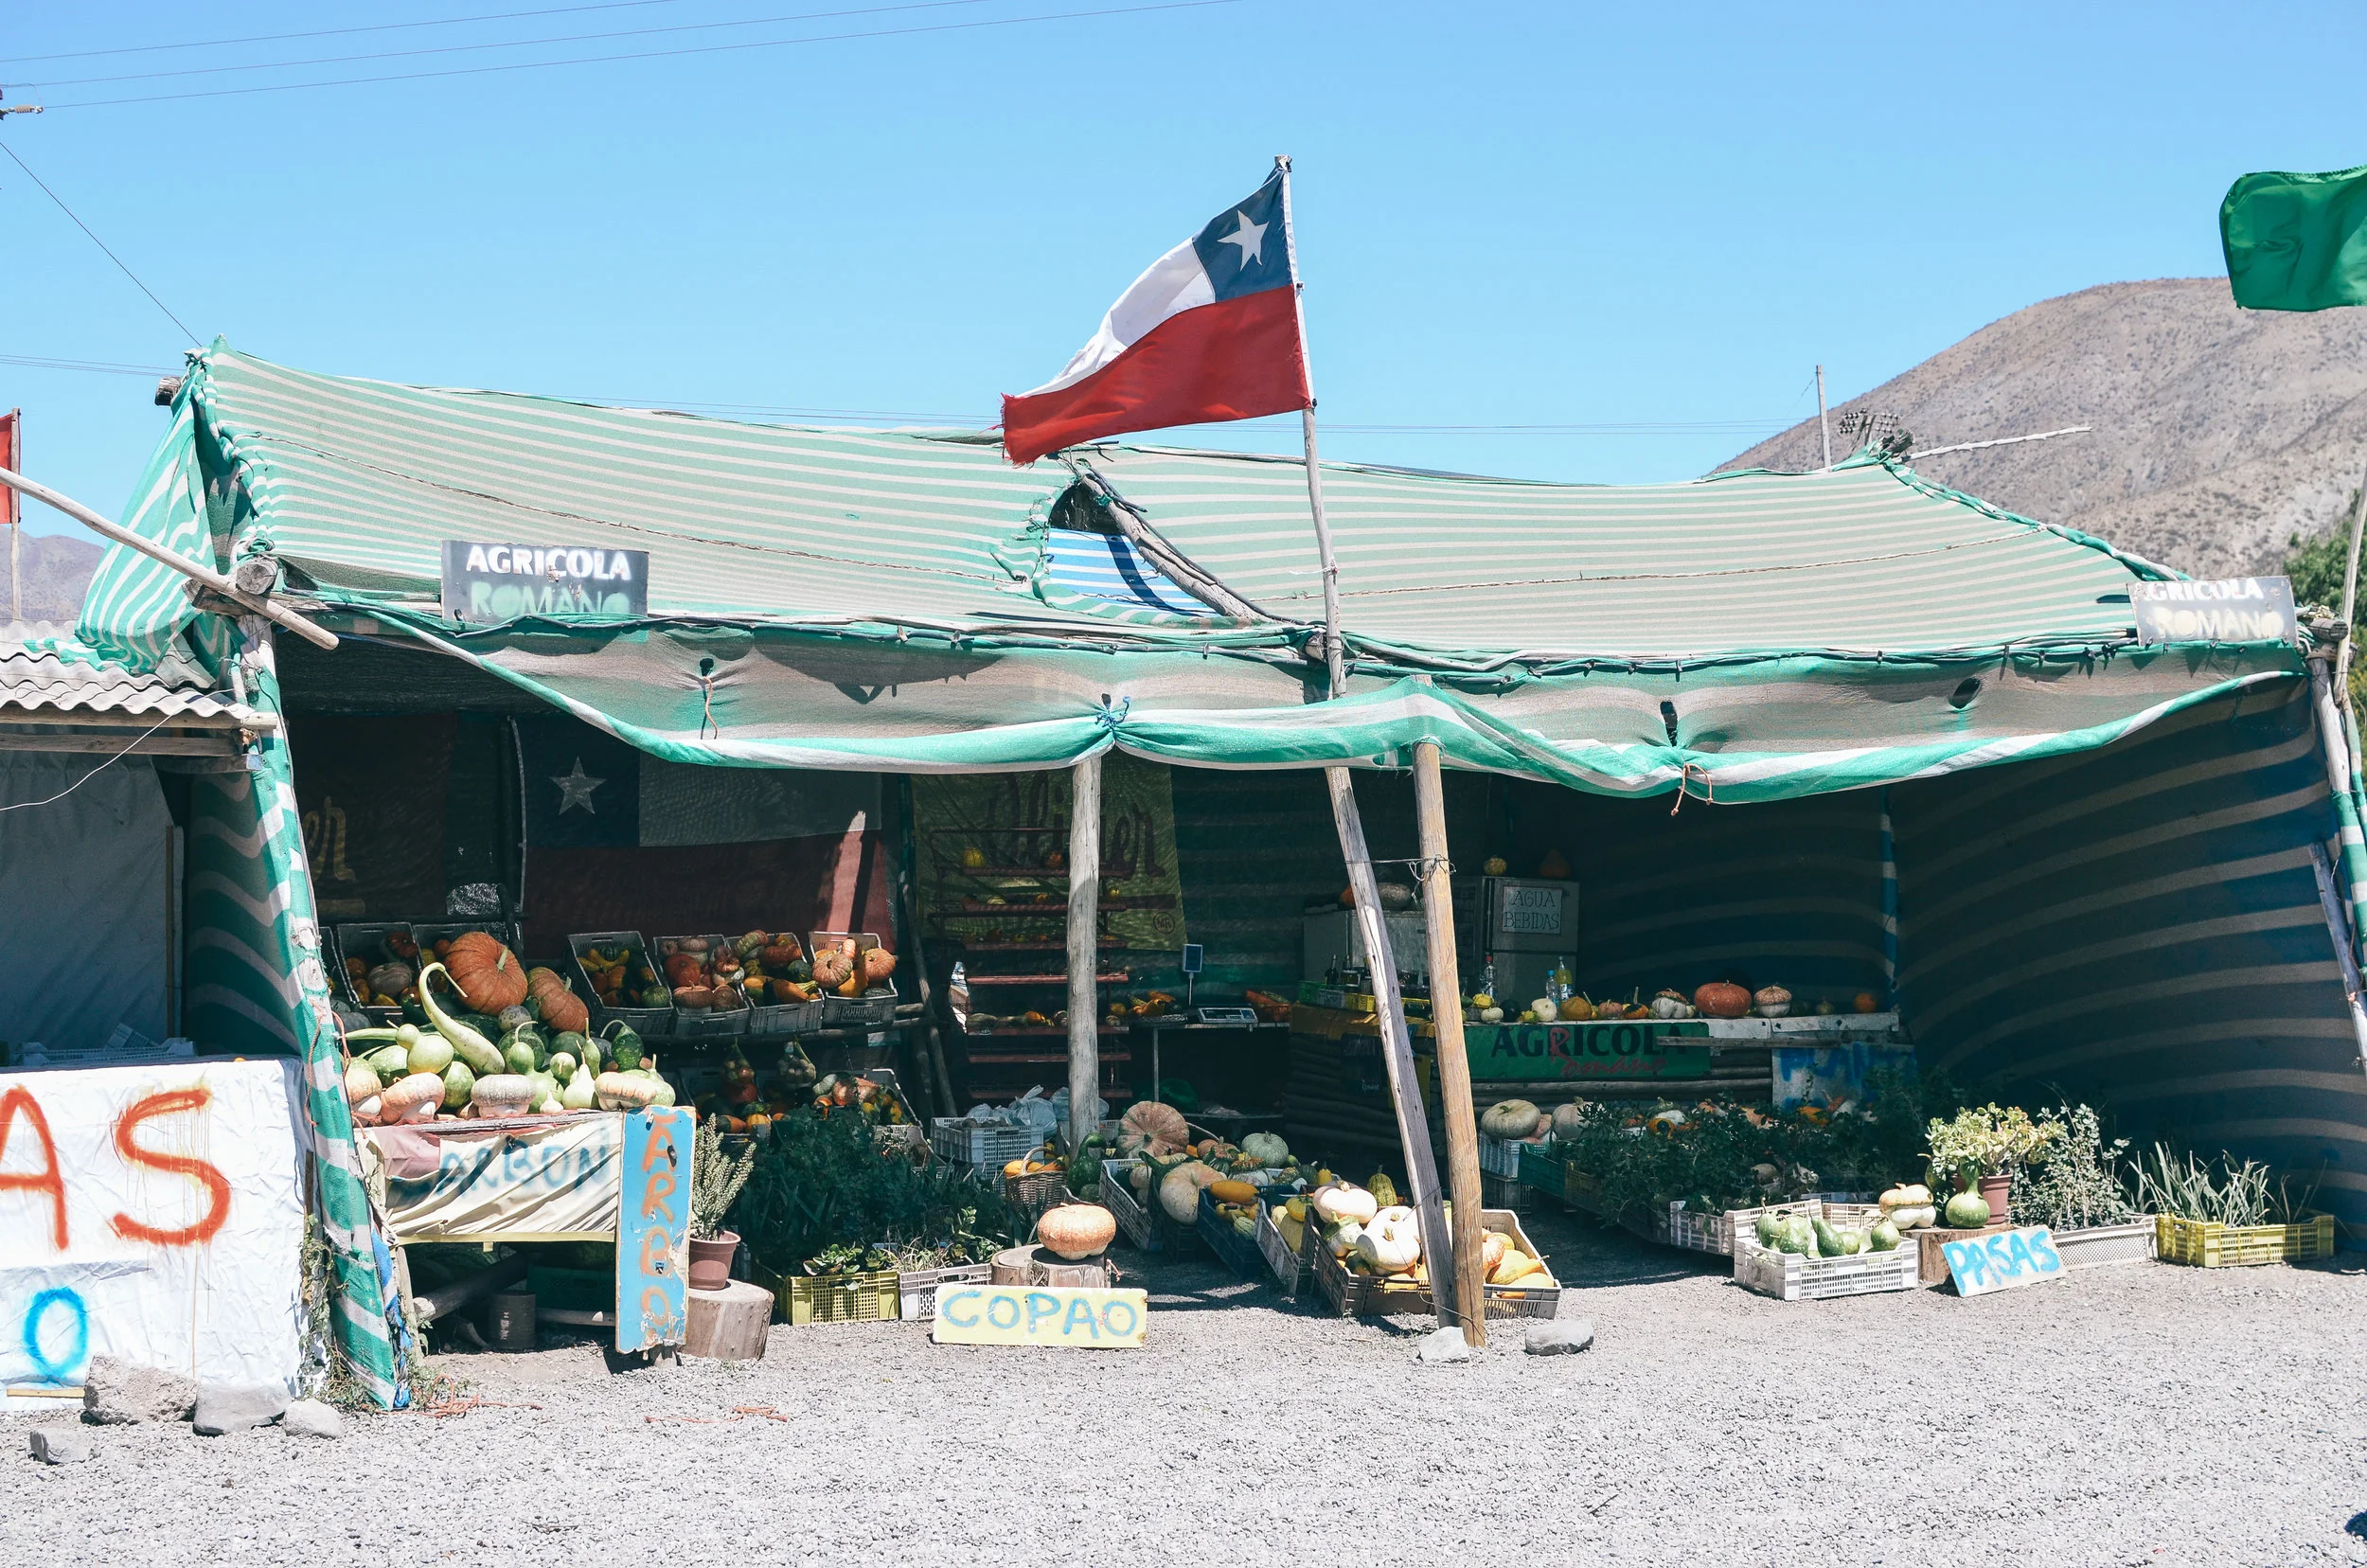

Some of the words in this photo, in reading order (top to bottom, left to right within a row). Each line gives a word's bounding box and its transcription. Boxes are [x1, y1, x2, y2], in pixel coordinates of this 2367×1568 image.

[466, 544, 632, 580] AGRICOLA
[471, 580, 630, 616] ROMANO
[2147, 605, 2285, 639] ROMANO
[1511, 890, 1555, 907] AGUA
[1504, 911, 1559, 930] BEBIDAS
[1491, 1025, 1687, 1058] AGRICOLA
[388, 1124, 612, 1199] ARBON
[1942, 1231, 2061, 1295] PASAS
[941, 1290, 1137, 1340] COPAO
